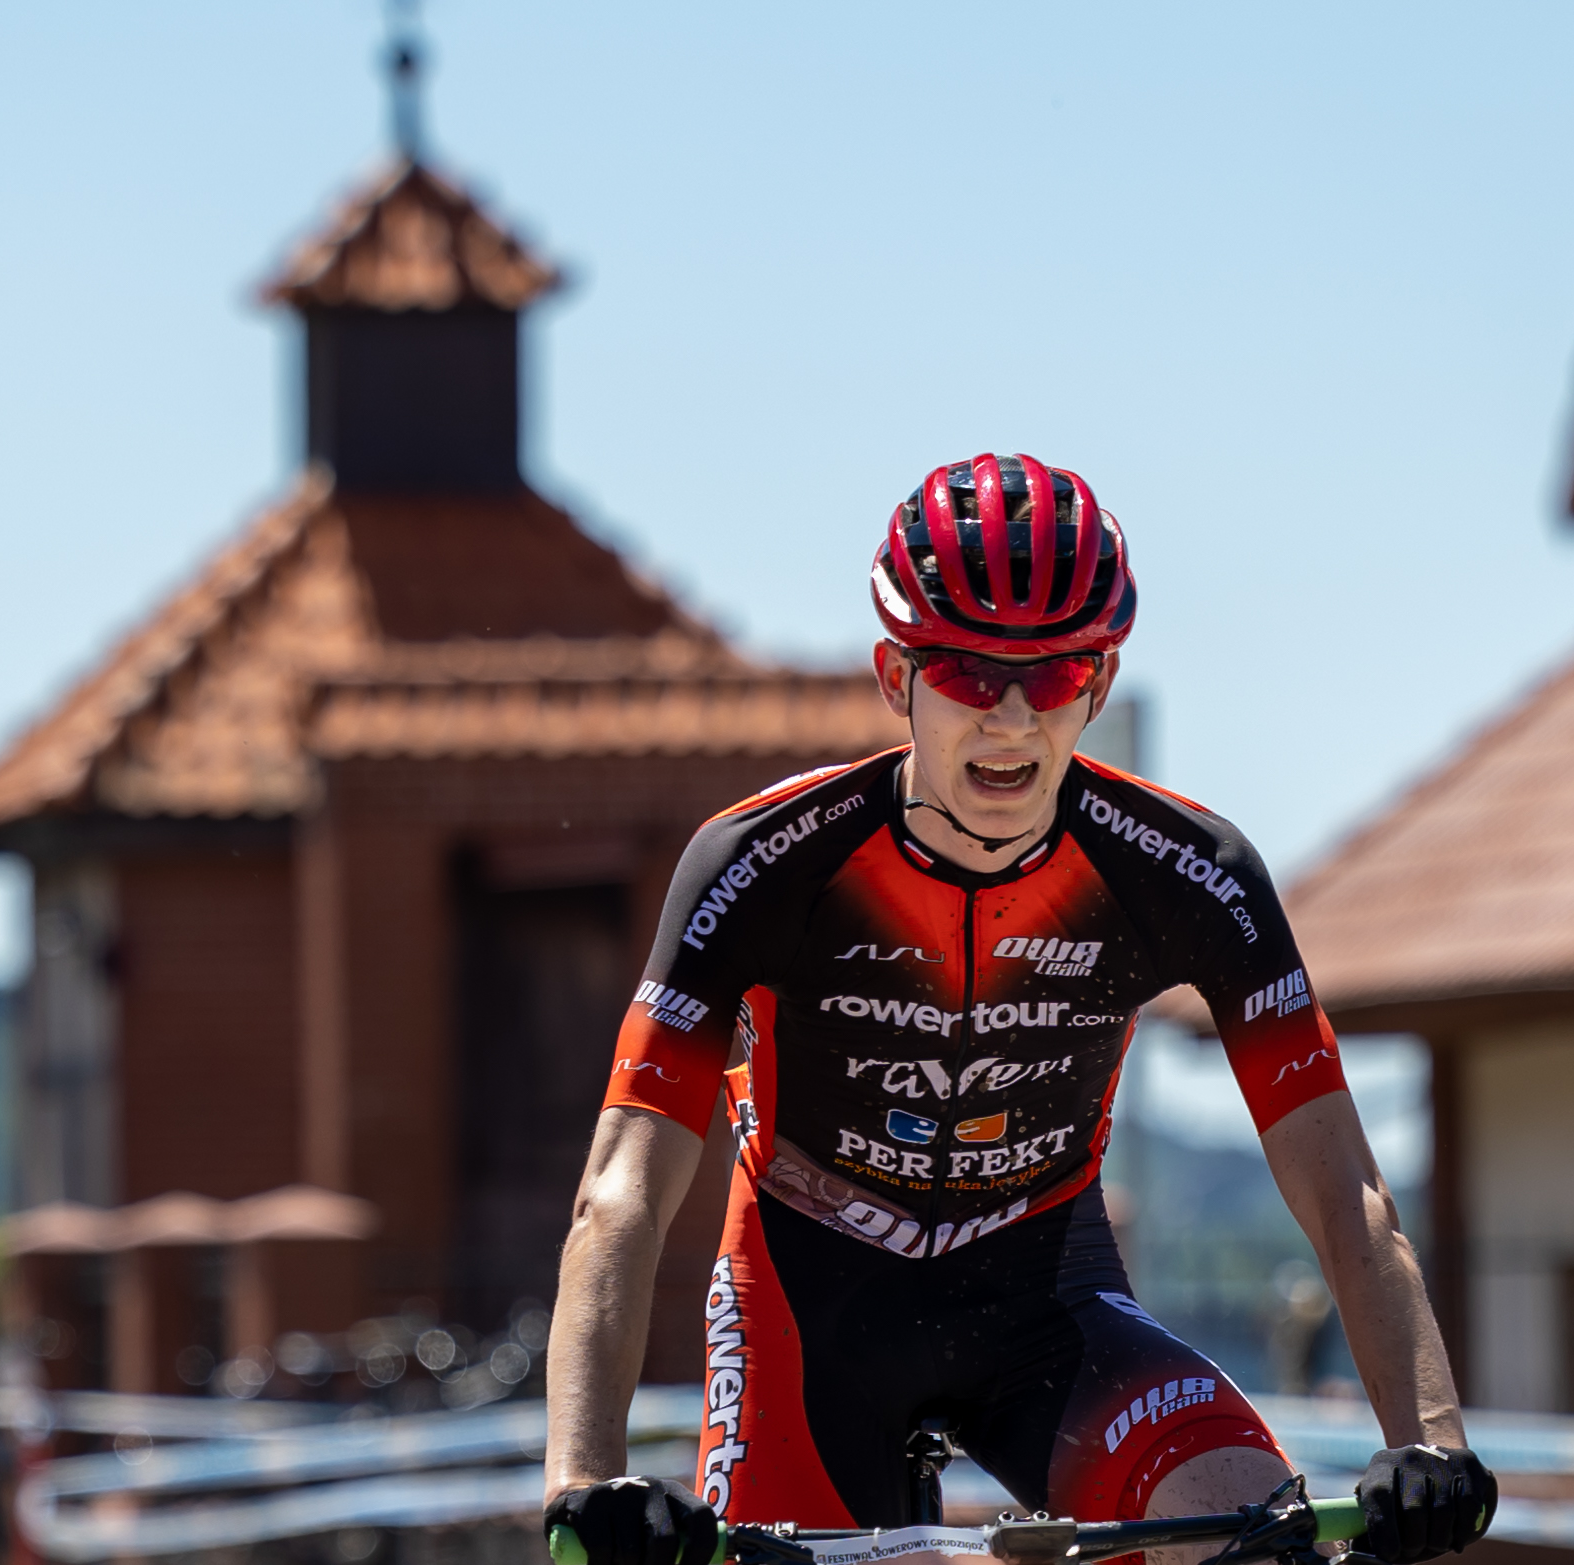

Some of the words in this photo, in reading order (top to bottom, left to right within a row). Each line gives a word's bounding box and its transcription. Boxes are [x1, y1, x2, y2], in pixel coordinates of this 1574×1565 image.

[682, 793, 864, 951] rowertour.com
[1079, 788, 1258, 944] rowertour.com
[820, 995, 1124, 1037] rowertour.com
[828, 1552, 874, 1564] FESTIWAL
